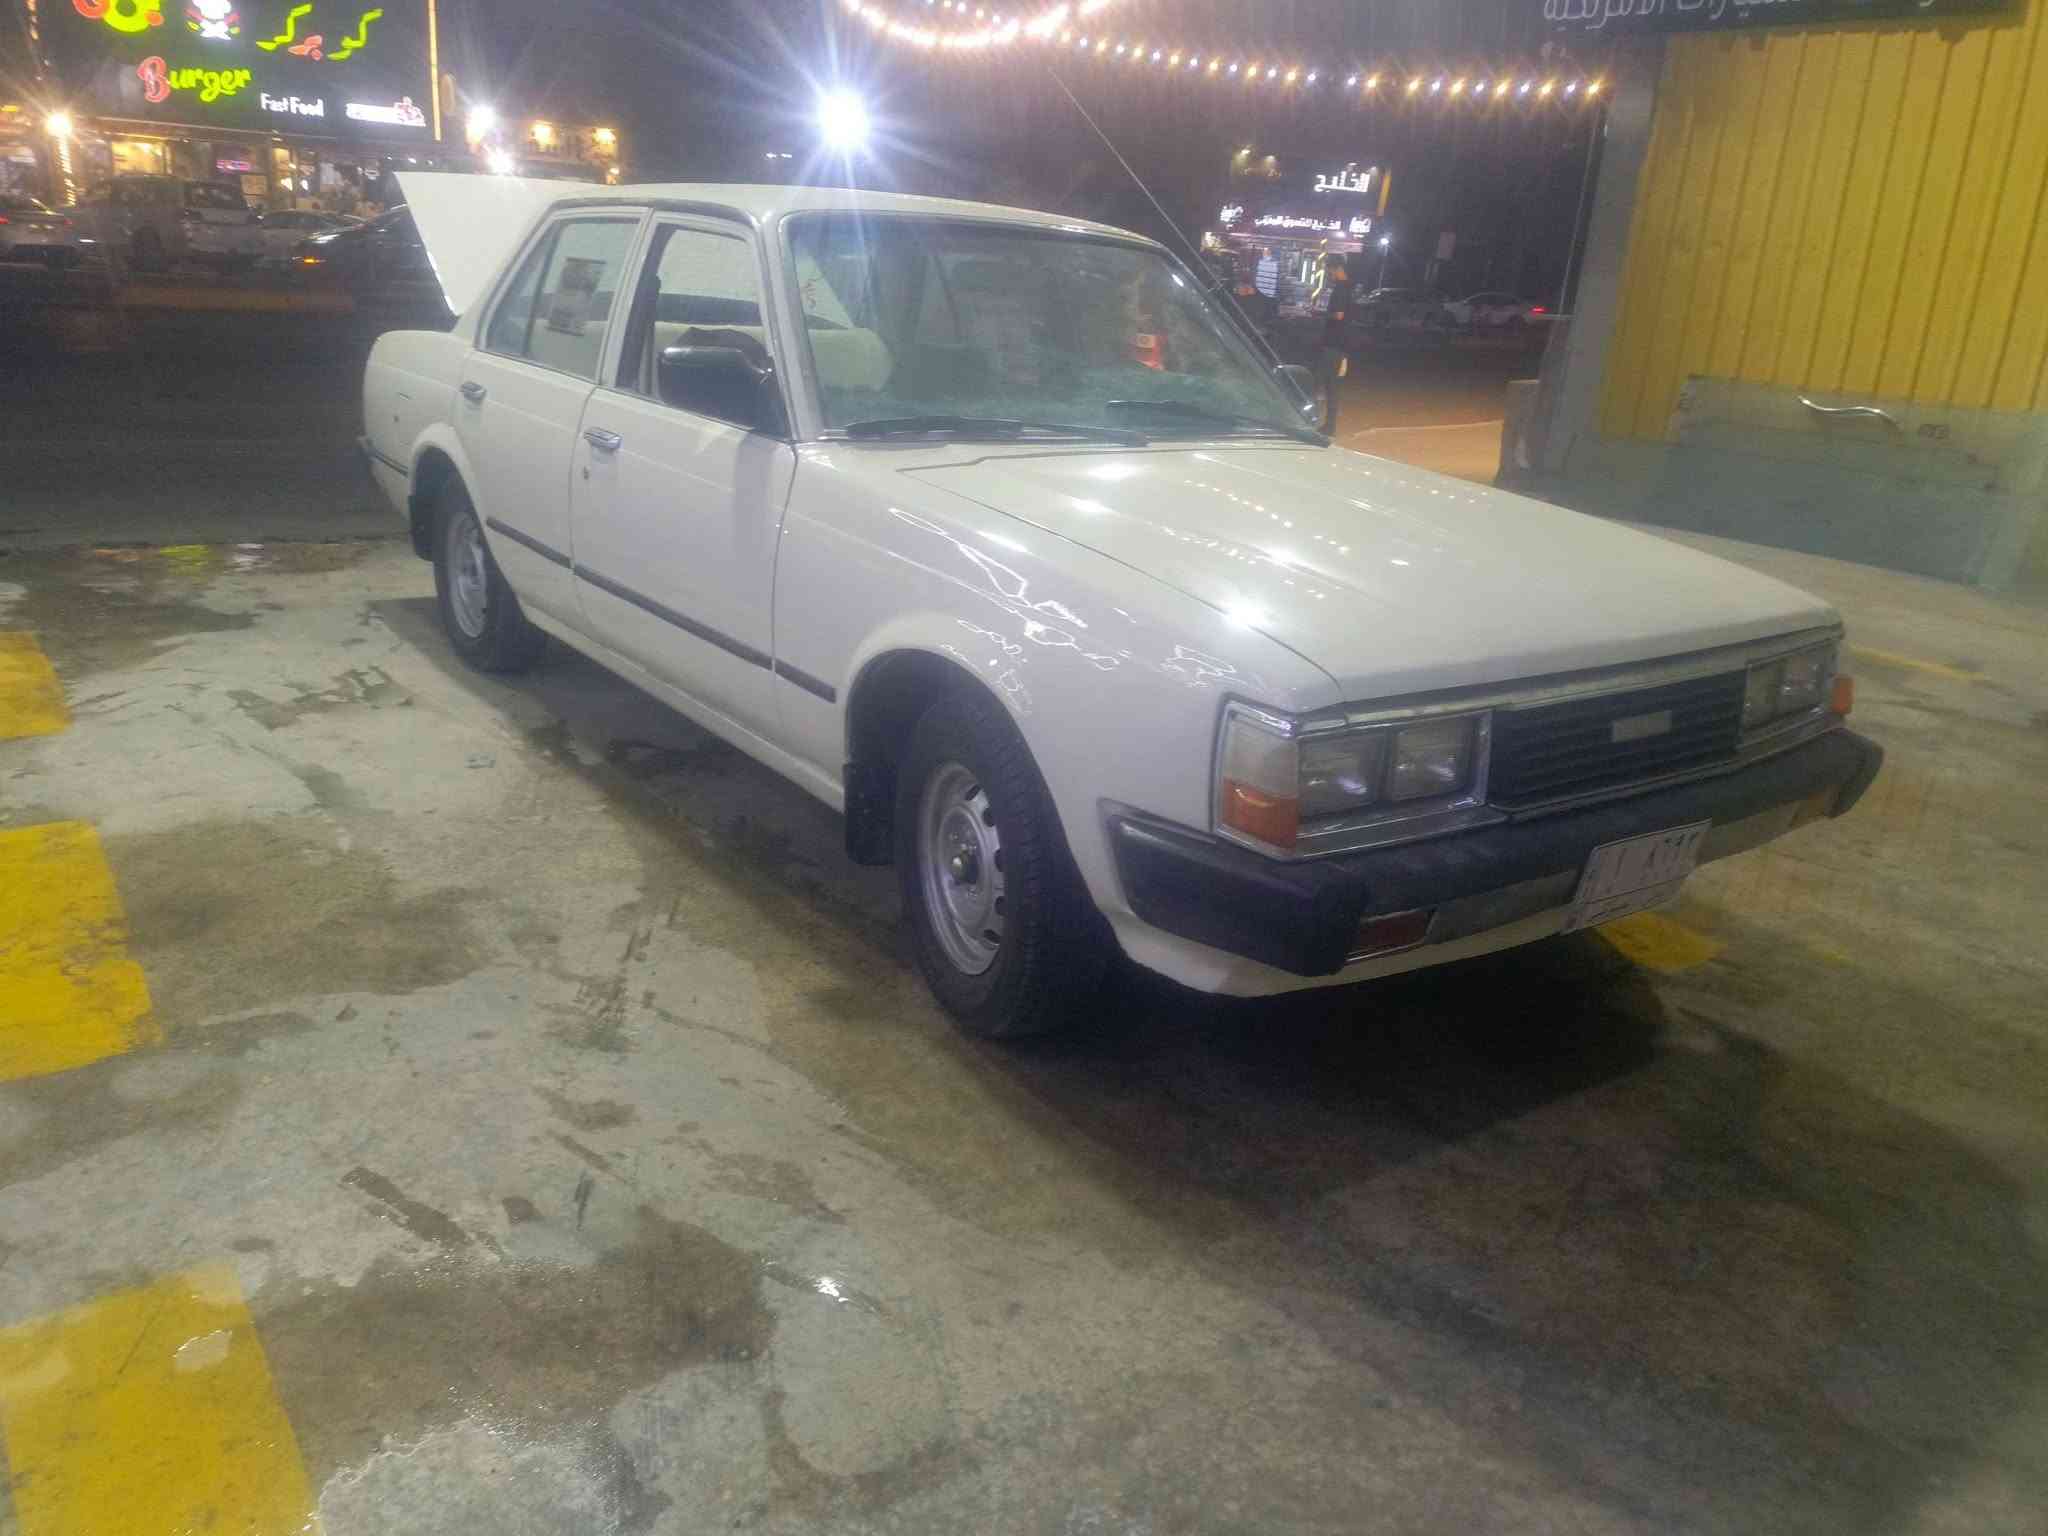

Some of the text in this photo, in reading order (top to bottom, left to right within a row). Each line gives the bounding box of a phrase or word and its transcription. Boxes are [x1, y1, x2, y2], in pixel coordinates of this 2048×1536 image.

[136, 56, 252, 102] Burger
[260, 92, 288, 112] Fast
[289, 96, 324, 118] Food
[1313, 170, 1371, 193] الخليج
